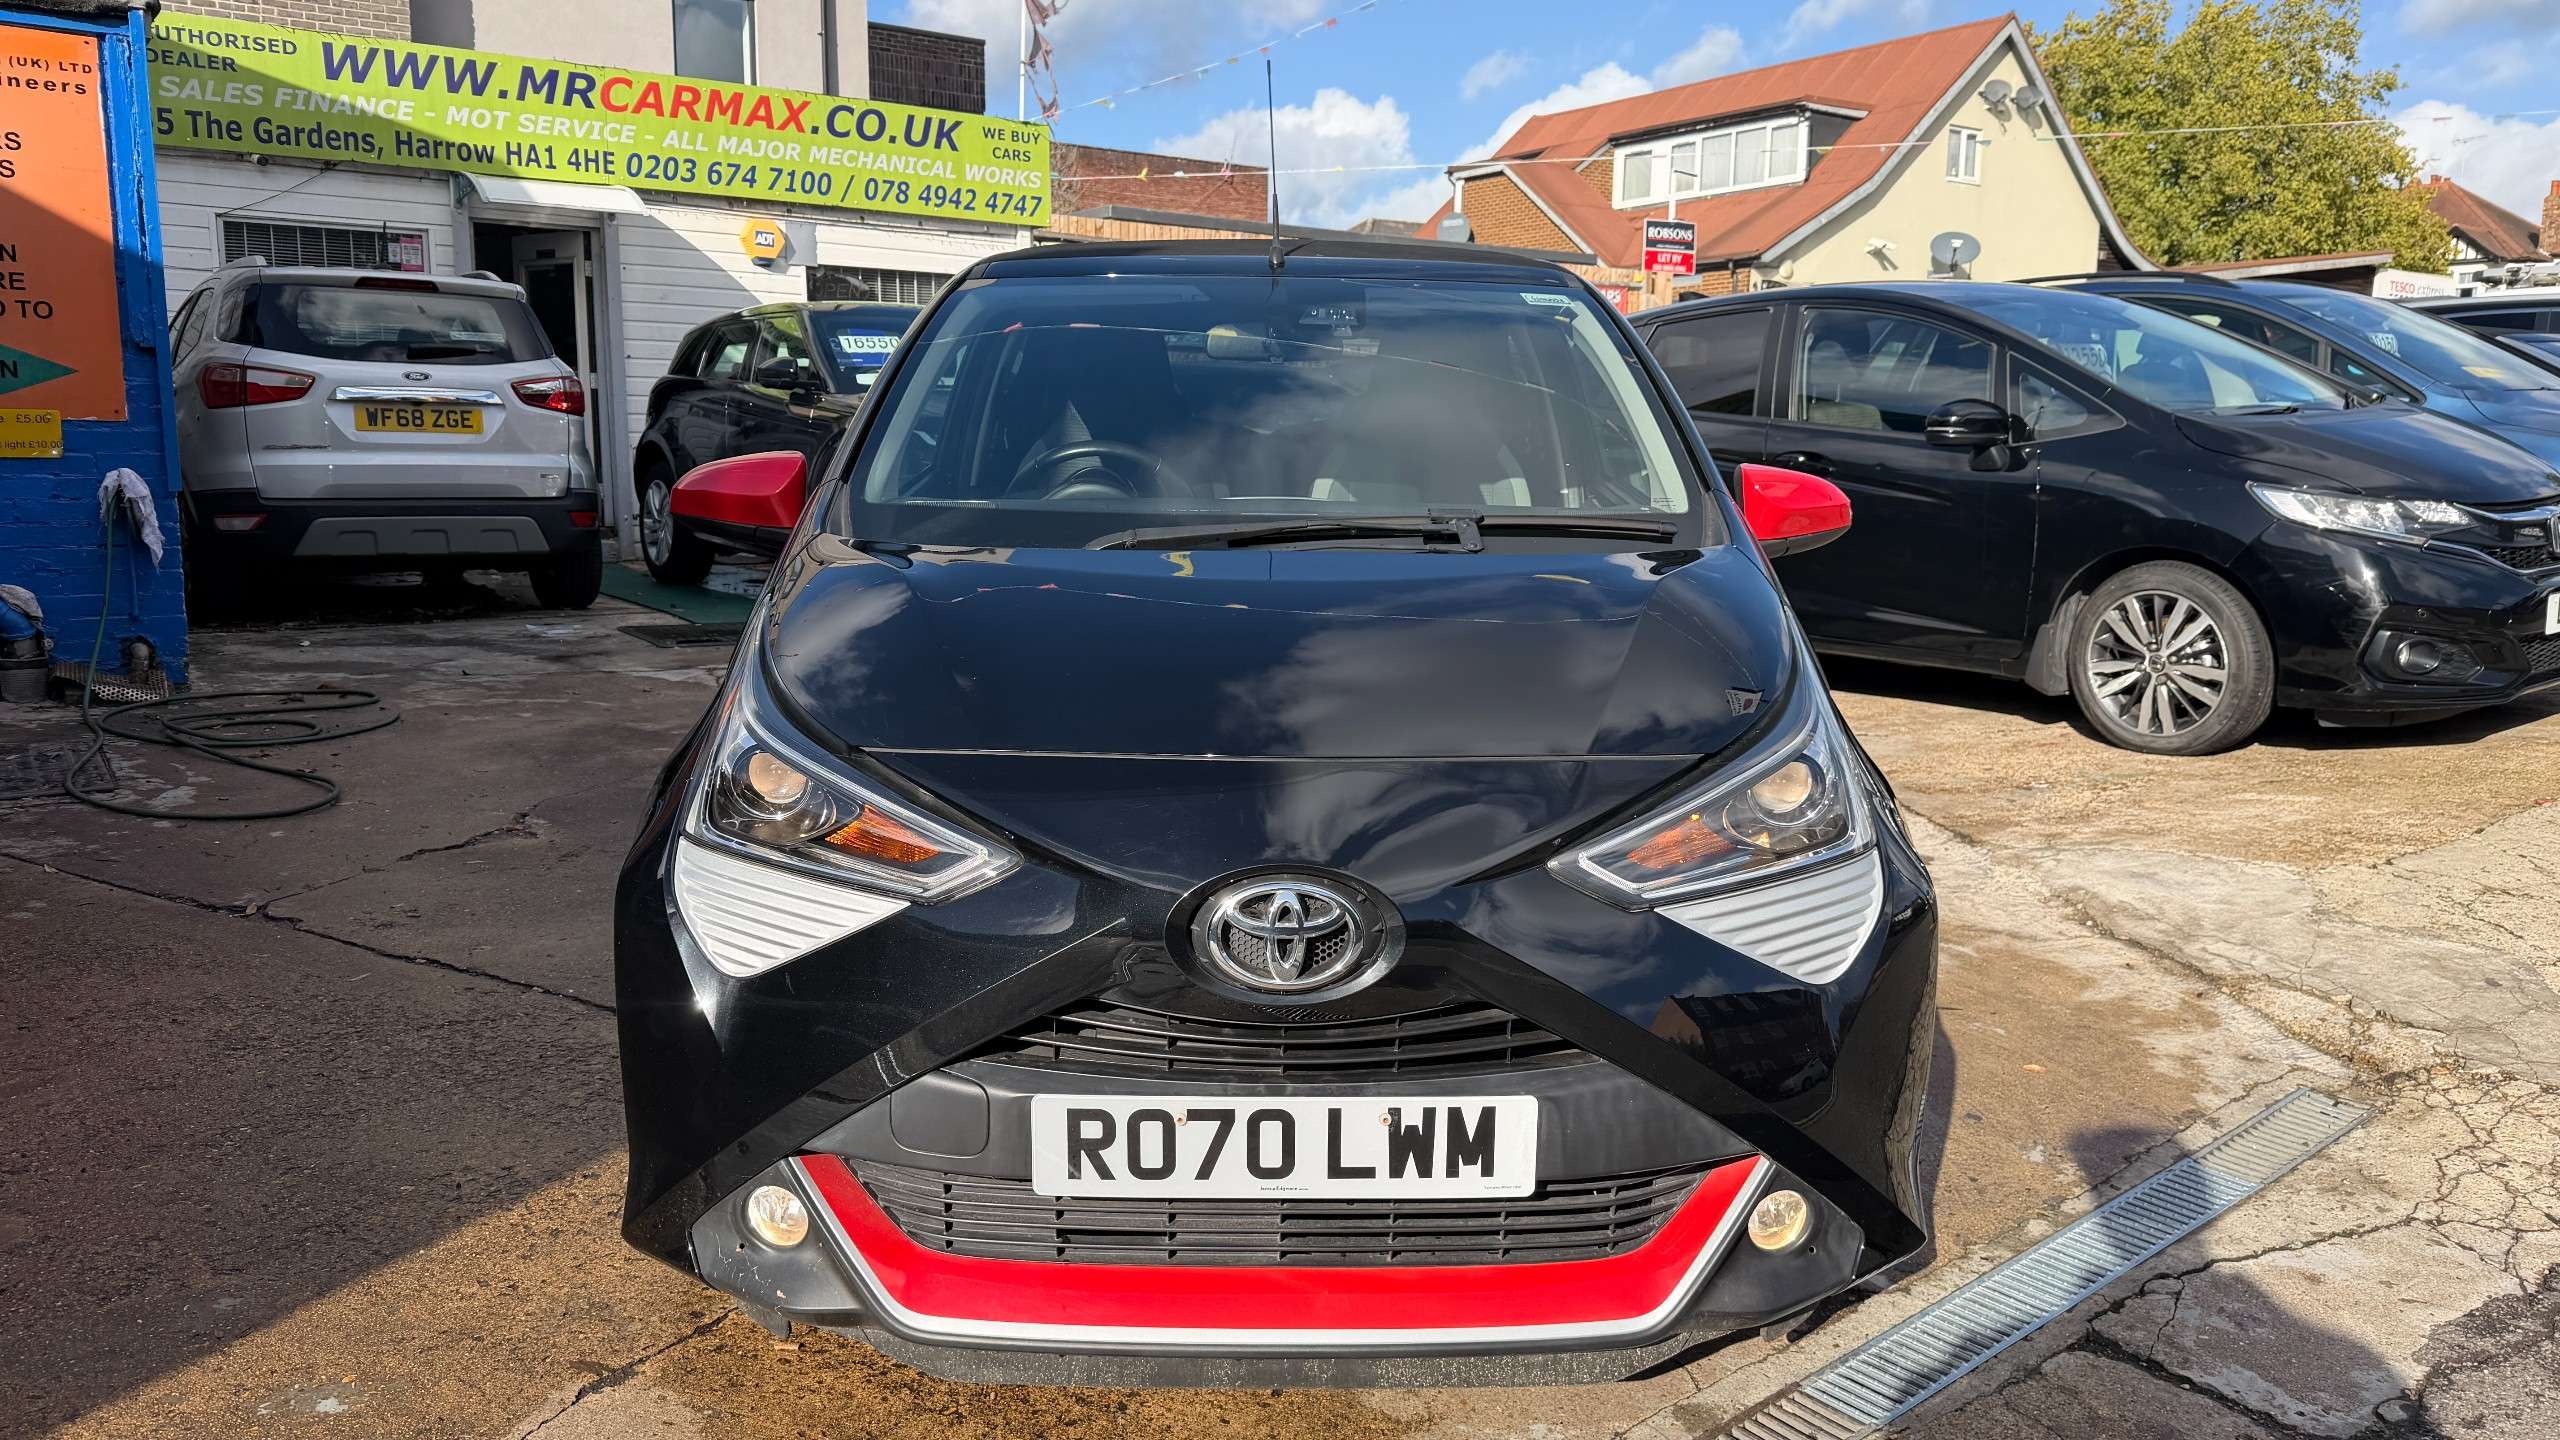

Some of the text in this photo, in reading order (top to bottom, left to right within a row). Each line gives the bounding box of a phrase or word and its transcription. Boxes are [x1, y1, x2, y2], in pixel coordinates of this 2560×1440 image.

[151, 24, 297, 55] UTHORISED
[9, 56, 92, 74] (UK) LTD
[146, 47, 238, 72] DEALER
[322, 41, 963, 152] WWW.MRCARMAX.CO.UK
[159, 75, 263, 106] SALES
[275, 88, 415, 121] FINANCE
[446, 105, 511, 131] MOT
[518, 113, 637, 144] SERVICE
[662, 129, 708, 152] ALL
[717, 135, 801, 162] MAJOR
[809, 145, 956, 180] MECHANICAL
[965, 163, 1042, 189] WORKS
[982, 126, 1041, 146] WE BUY
[184, 109, 243, 142] The
[253, 116, 384, 160] Gardens,
[395, 130, 495, 165] Harrow
[506, 141, 557, 170] HA1
[567, 147, 615, 175] 4HE
[626, 152, 697, 183] 0203
[708, 160, 757, 189] 674
[767, 167, 832, 196] 7100
[864, 177, 910, 205] 078
[918, 184, 976, 212] 4942
[985, 192, 1042, 217] 4747
[992, 146, 1032, 163] CARS
[756, 232, 774, 246] ADT
[1648, 227, 1693, 241] ROBSONS
[2391, 280, 2416, 295] TESCO
[14, 299, 54, 320] TO
[844, 337, 899, 350] 16550
[365, 407, 474, 429] WF68 ZGE
[1066, 1106, 1497, 1181] RO70 LWM
